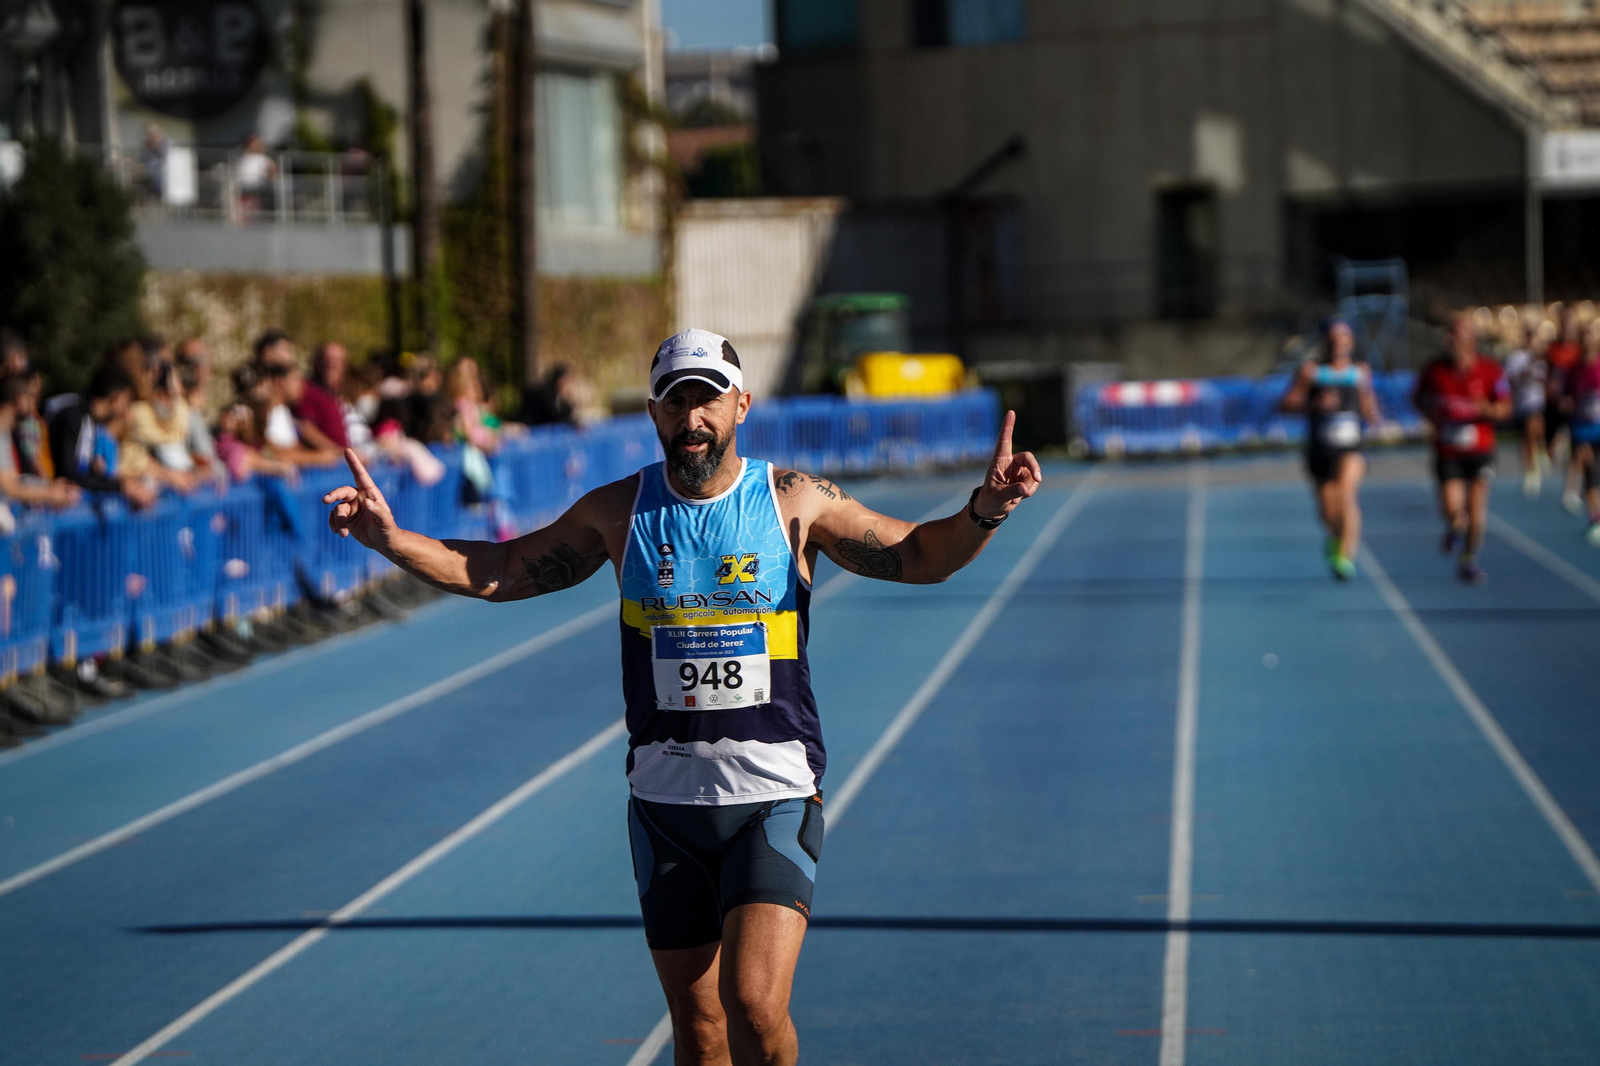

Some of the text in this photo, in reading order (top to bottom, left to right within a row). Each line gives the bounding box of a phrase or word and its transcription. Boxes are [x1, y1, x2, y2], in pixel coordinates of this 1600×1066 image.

[641, 588, 772, 611] RUBYSAN
[644, 606, 772, 621] industria agrícola automoción
[667, 627, 754, 638] XLIII Carrera Popular
[676, 641, 706, 649] Ciudad
[720, 640, 744, 648] Jerez
[679, 660, 743, 692] 948
[794, 899, 810, 918] WO
